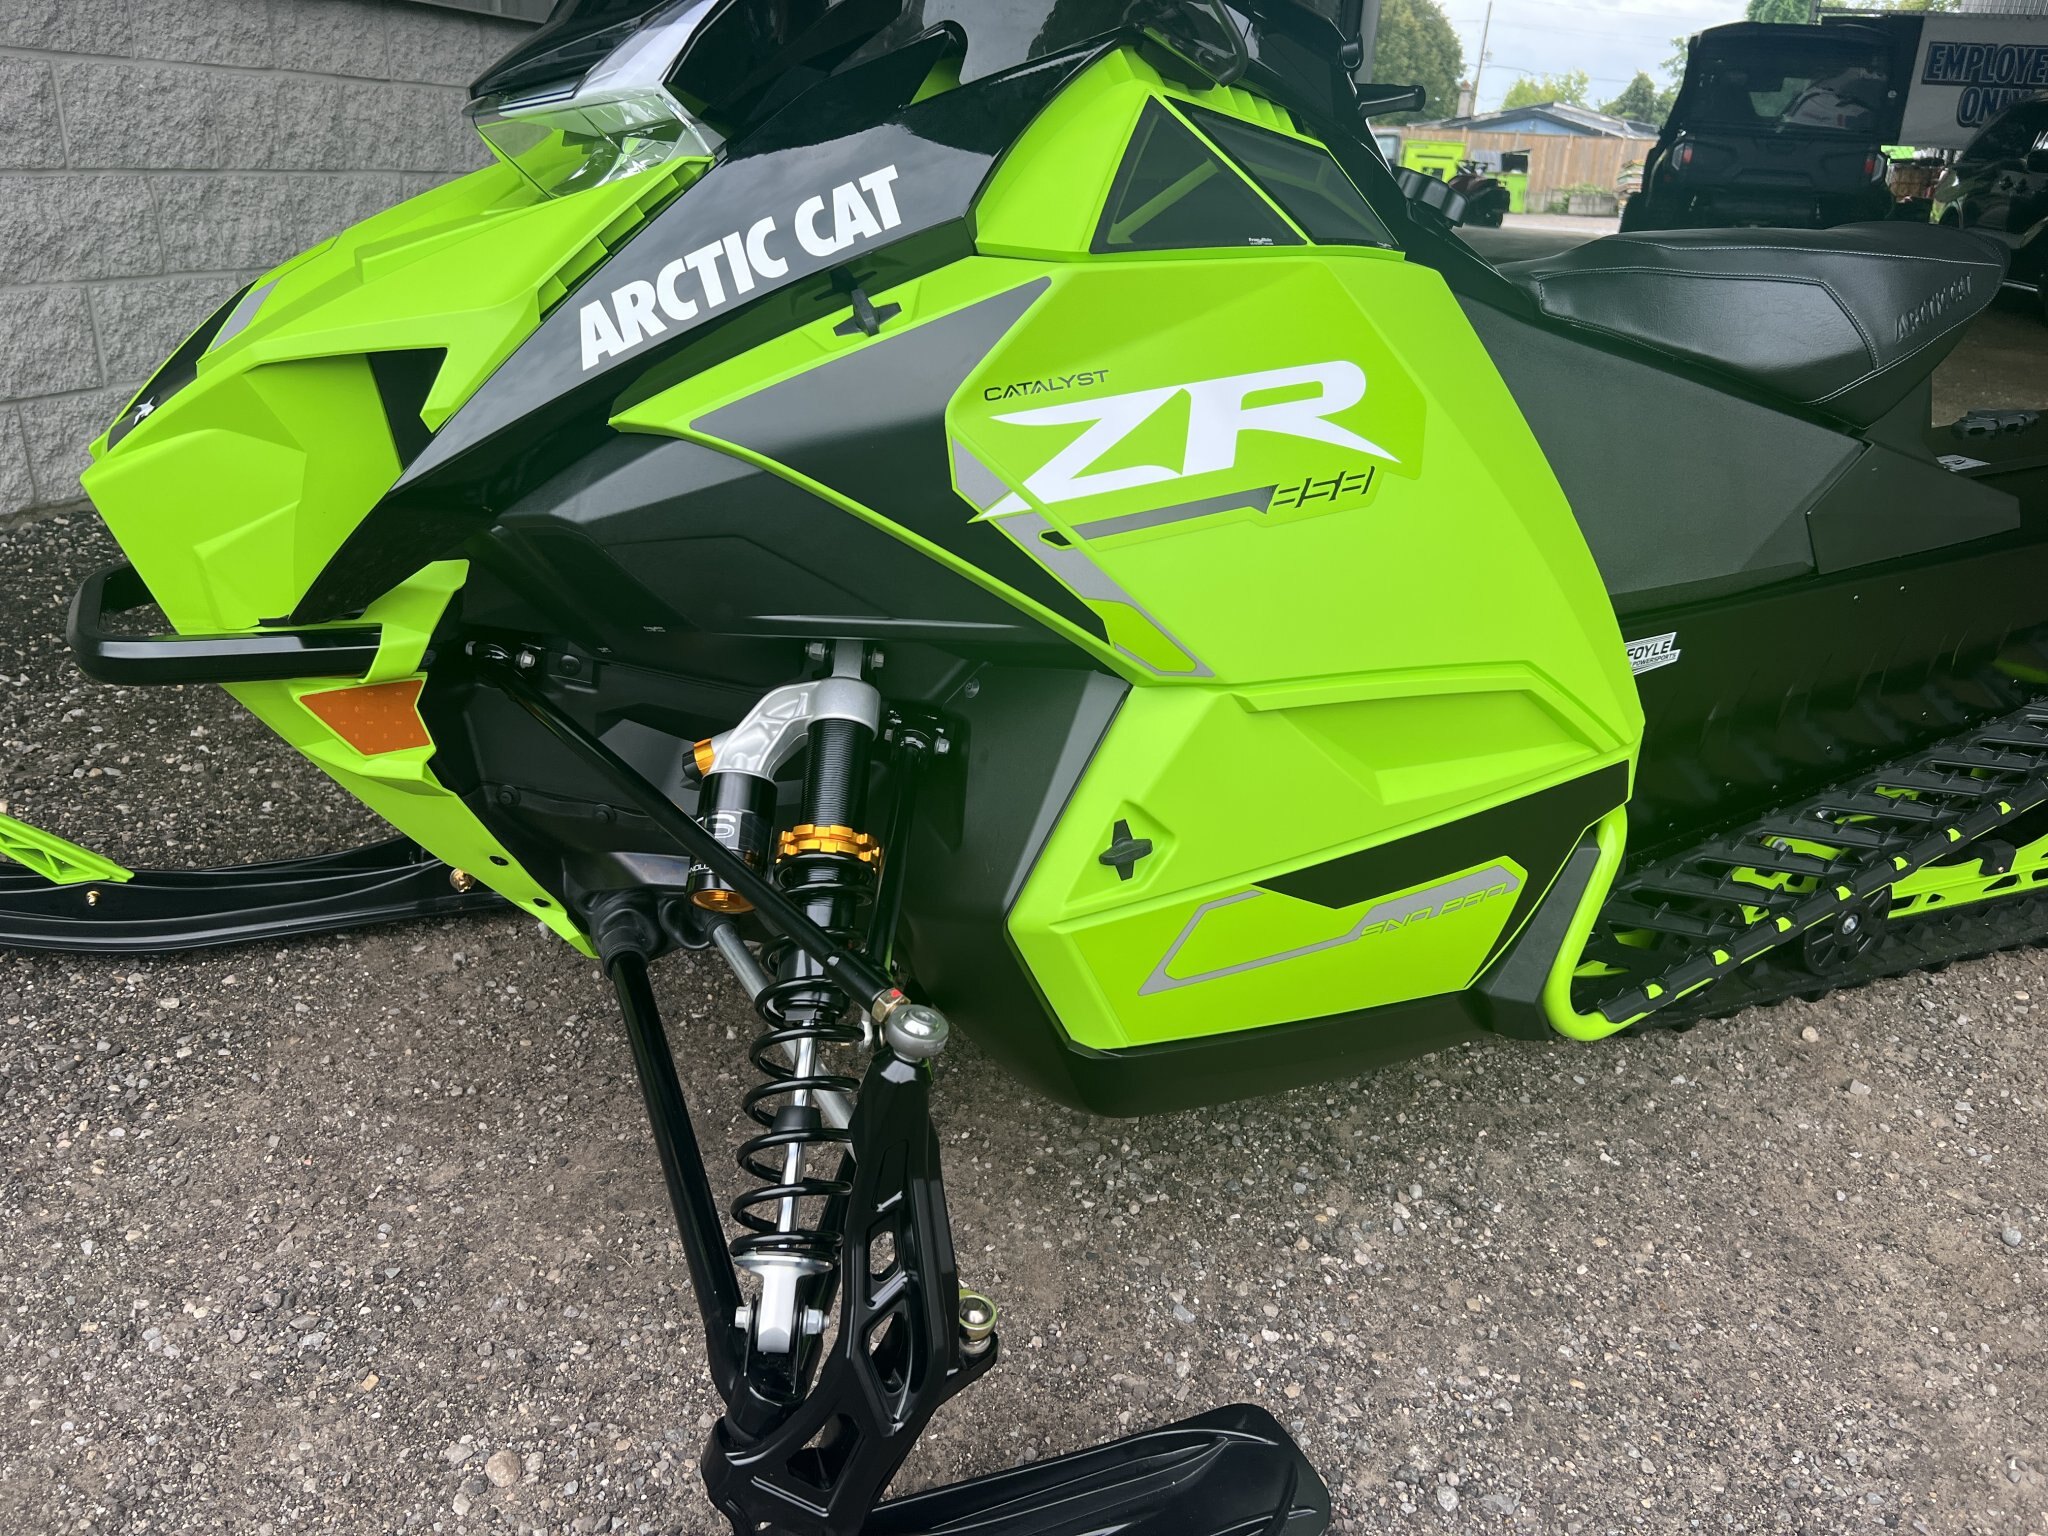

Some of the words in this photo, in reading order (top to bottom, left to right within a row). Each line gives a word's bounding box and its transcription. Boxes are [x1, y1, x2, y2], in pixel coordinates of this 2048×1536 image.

[1957, 86, 2034, 127] ON
[580, 216, 789, 371] ARCTIC
[794, 164, 903, 257] CAT
[984, 369, 1109, 401] CATALYST
[968, 360, 1402, 524] ZR
[1631, 653, 1677, 667] POWERSPORTS
[1361, 905, 1434, 936] SNO
[1438, 882, 1508, 917] PRO
